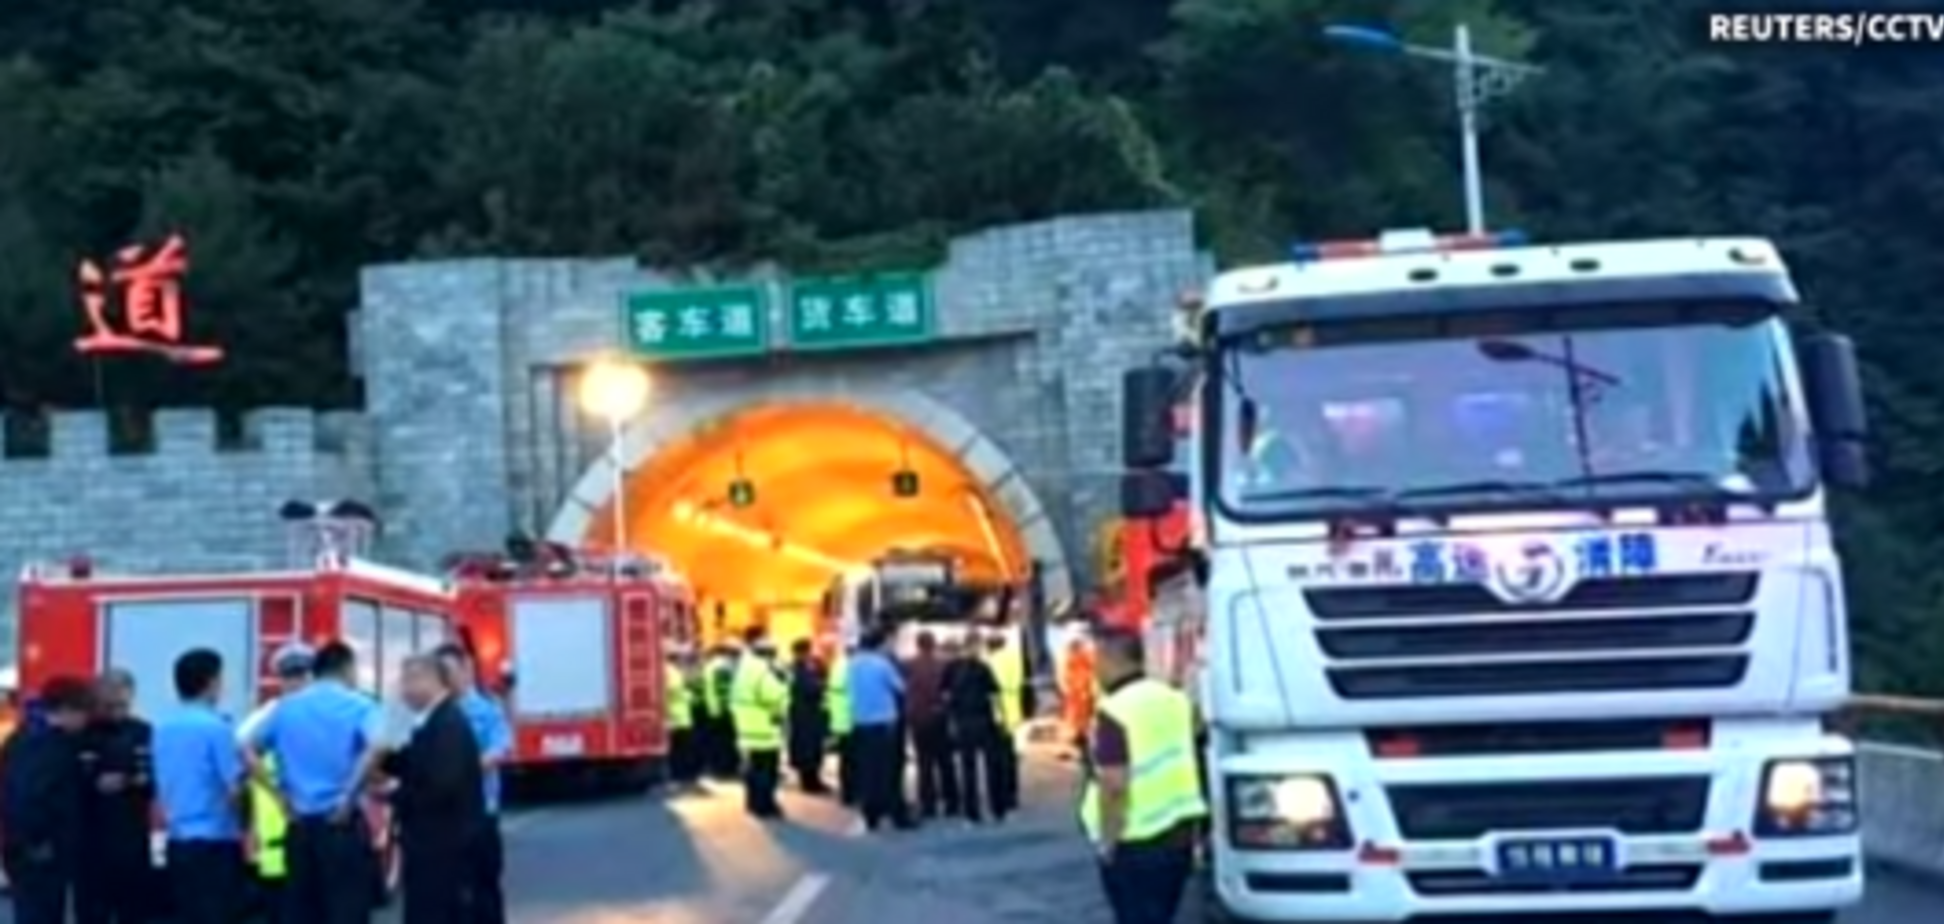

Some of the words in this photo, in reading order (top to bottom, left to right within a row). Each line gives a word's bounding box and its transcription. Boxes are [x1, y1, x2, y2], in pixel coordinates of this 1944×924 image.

[74, 234, 222, 361] 道
[634, 303, 751, 343] 客车道
